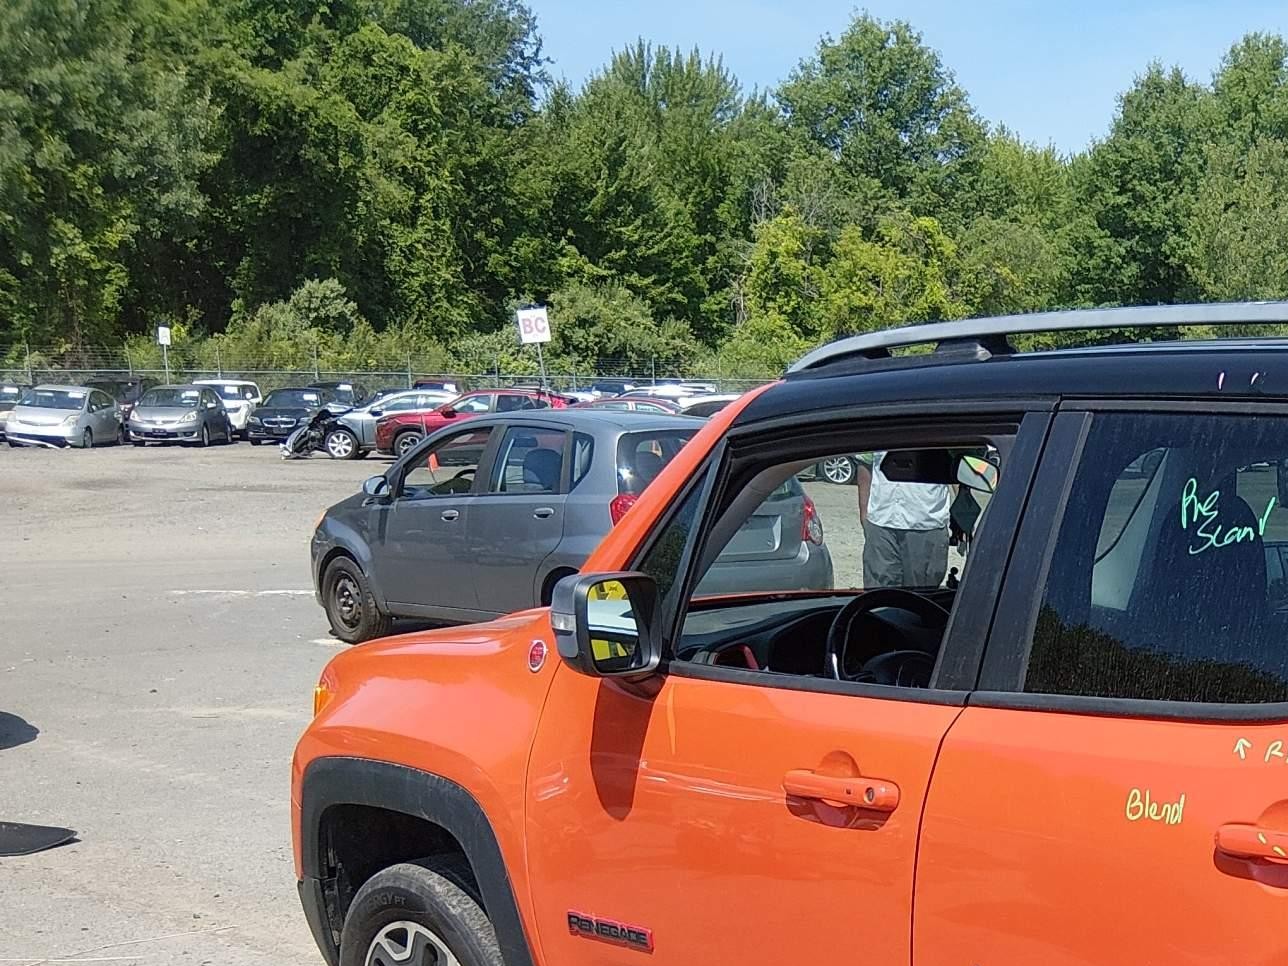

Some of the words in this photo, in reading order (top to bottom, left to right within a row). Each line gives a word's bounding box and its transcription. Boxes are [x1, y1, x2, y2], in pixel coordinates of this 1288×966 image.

[521, 316, 546, 335] BC
[1182, 478, 1219, 528] Pre
[1126, 788, 1186, 824] Blend
[567, 912, 651, 948] RENEGADE
